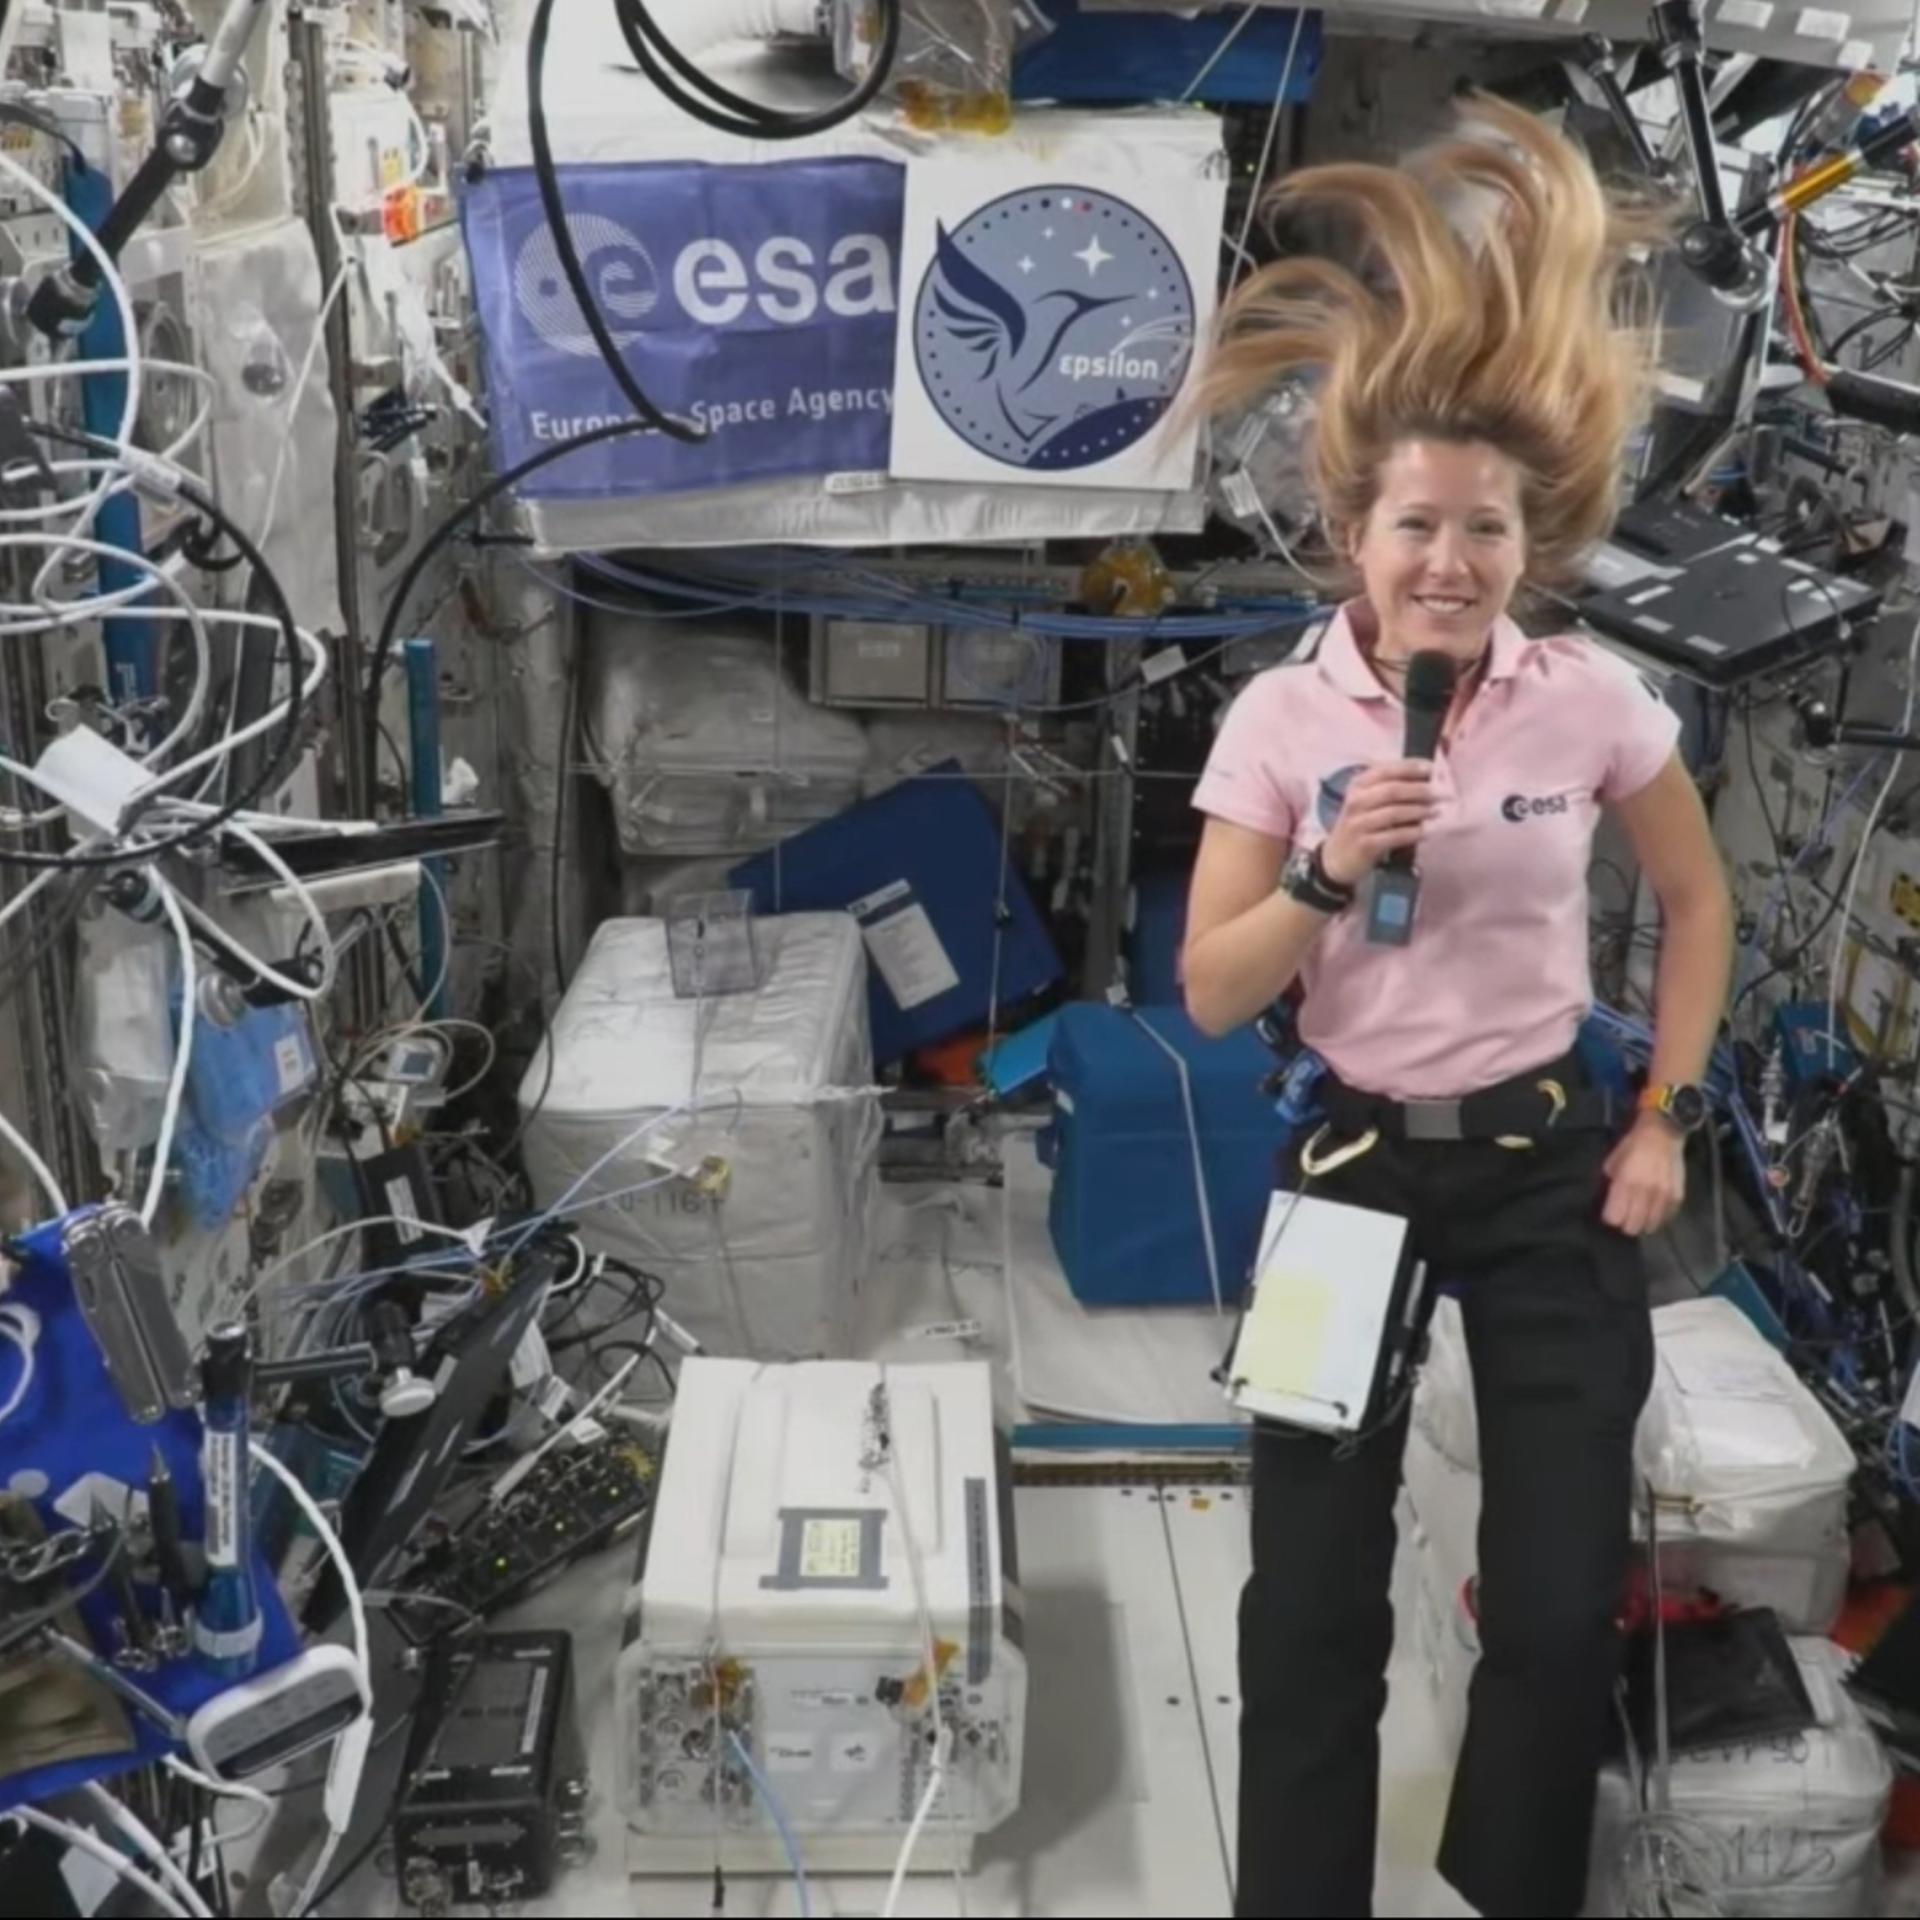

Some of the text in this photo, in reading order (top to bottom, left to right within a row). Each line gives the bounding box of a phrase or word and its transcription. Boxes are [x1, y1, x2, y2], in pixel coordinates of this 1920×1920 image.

[673, 233, 895, 325] esa
[691, 399, 775, 432] Space
[787, 387, 893, 420] Agency
[1532, 795, 1568, 816] esa
